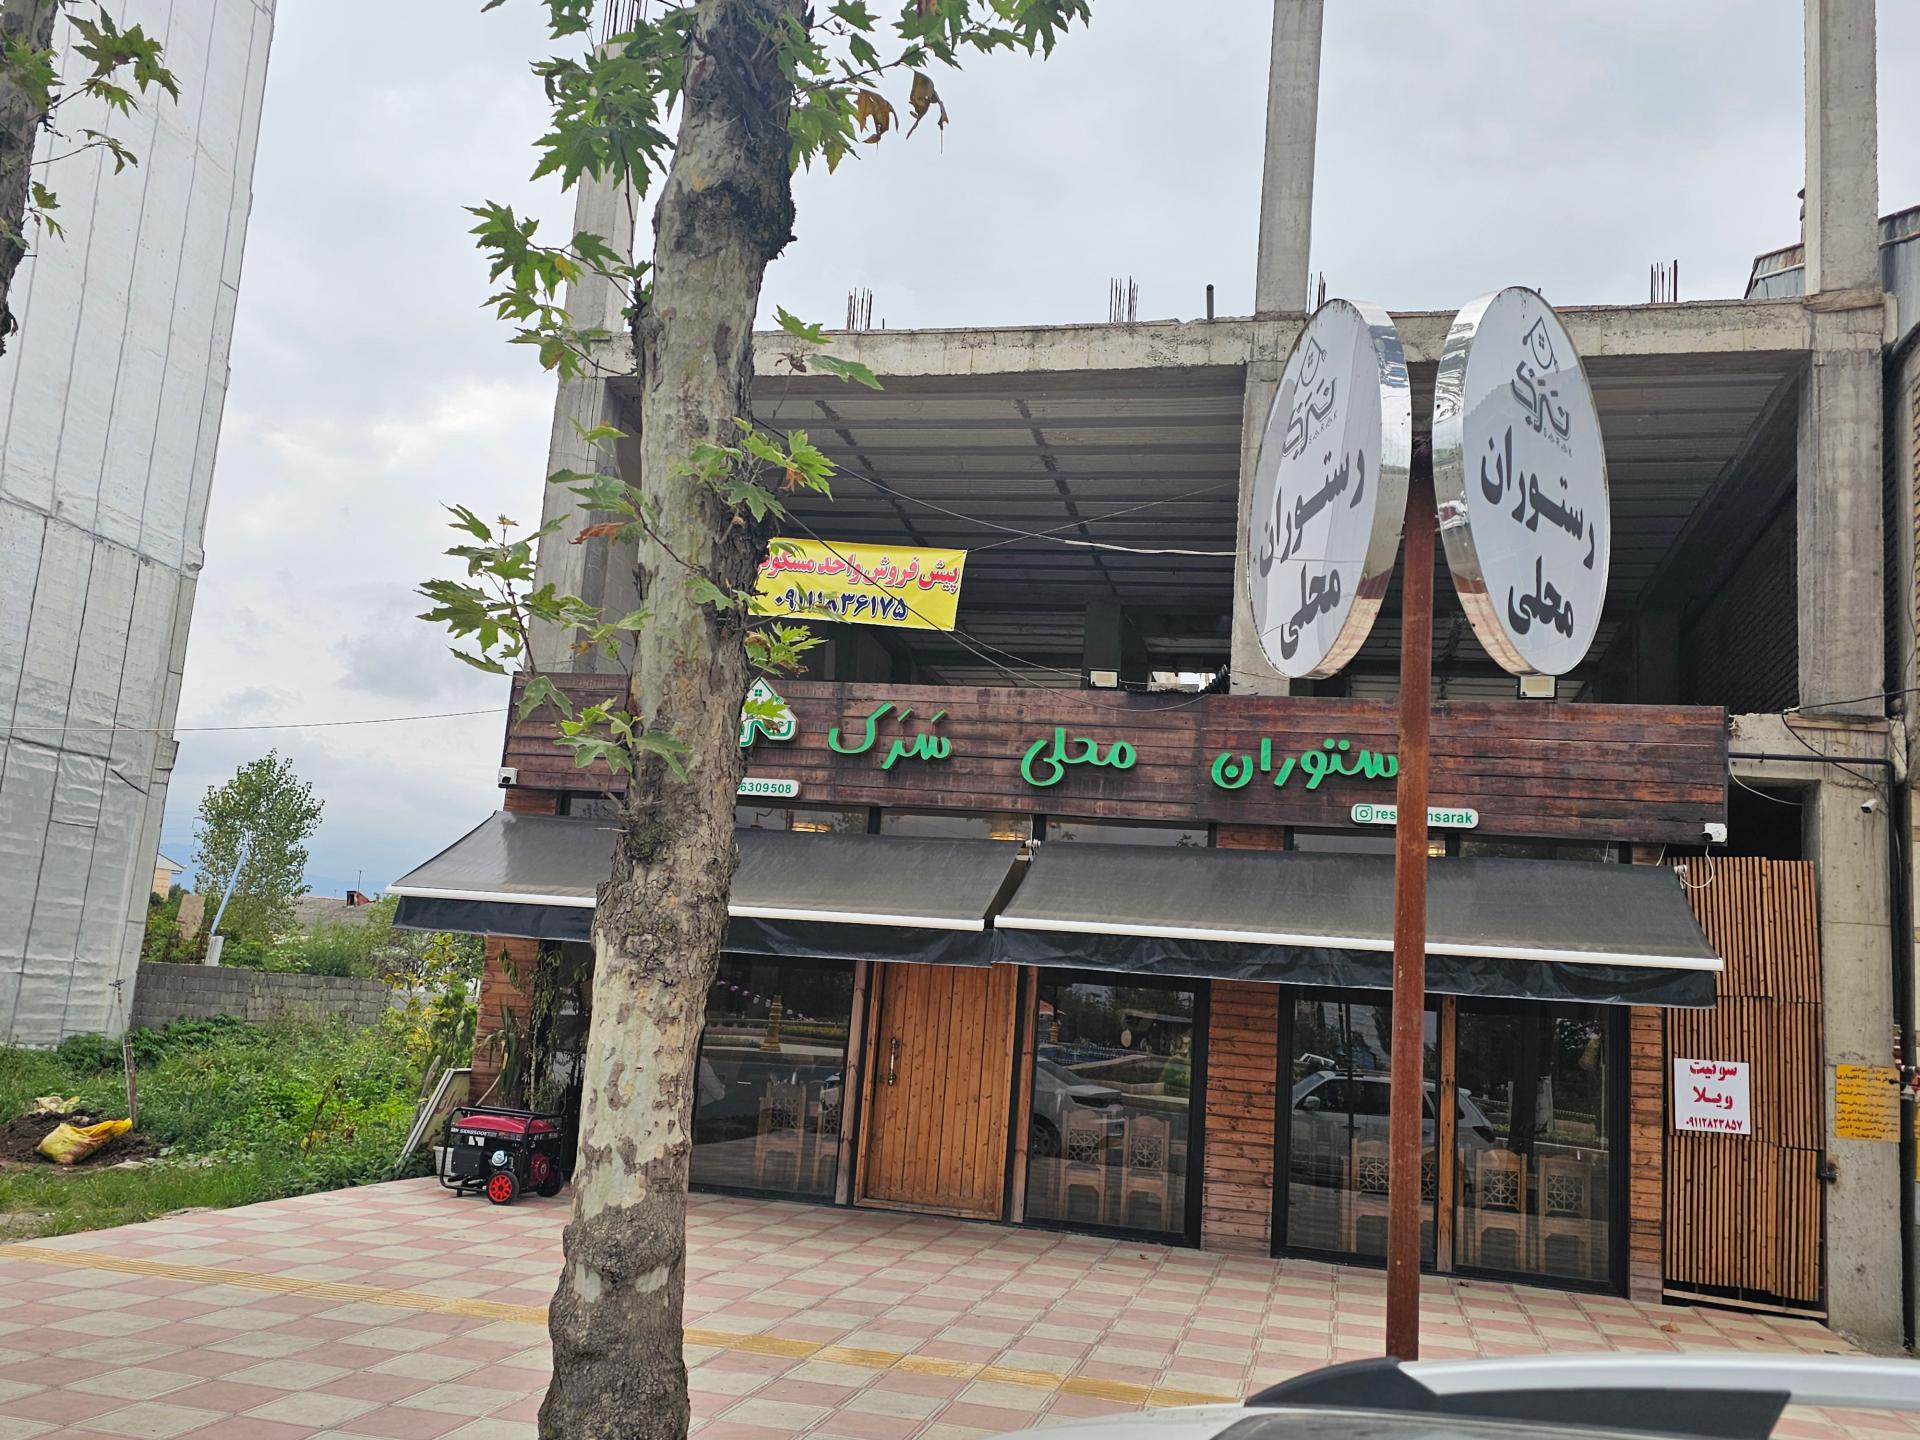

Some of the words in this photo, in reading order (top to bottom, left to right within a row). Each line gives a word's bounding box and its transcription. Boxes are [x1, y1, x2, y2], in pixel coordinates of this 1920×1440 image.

[1259, 448, 1365, 577] رستوران
[1481, 425, 1595, 569] رستوران
[817, 554, 862, 584] واحد
[864, 556, 920, 588] فروش
[918, 560, 961, 592] پیش
[1508, 555, 1574, 638] محلی
[1280, 562, 1341, 660] محلی
[1020, 726, 1138, 787] محلی
[1211, 737, 1398, 790] ستوران
[1693, 1086, 1733, 1109] ویلا
